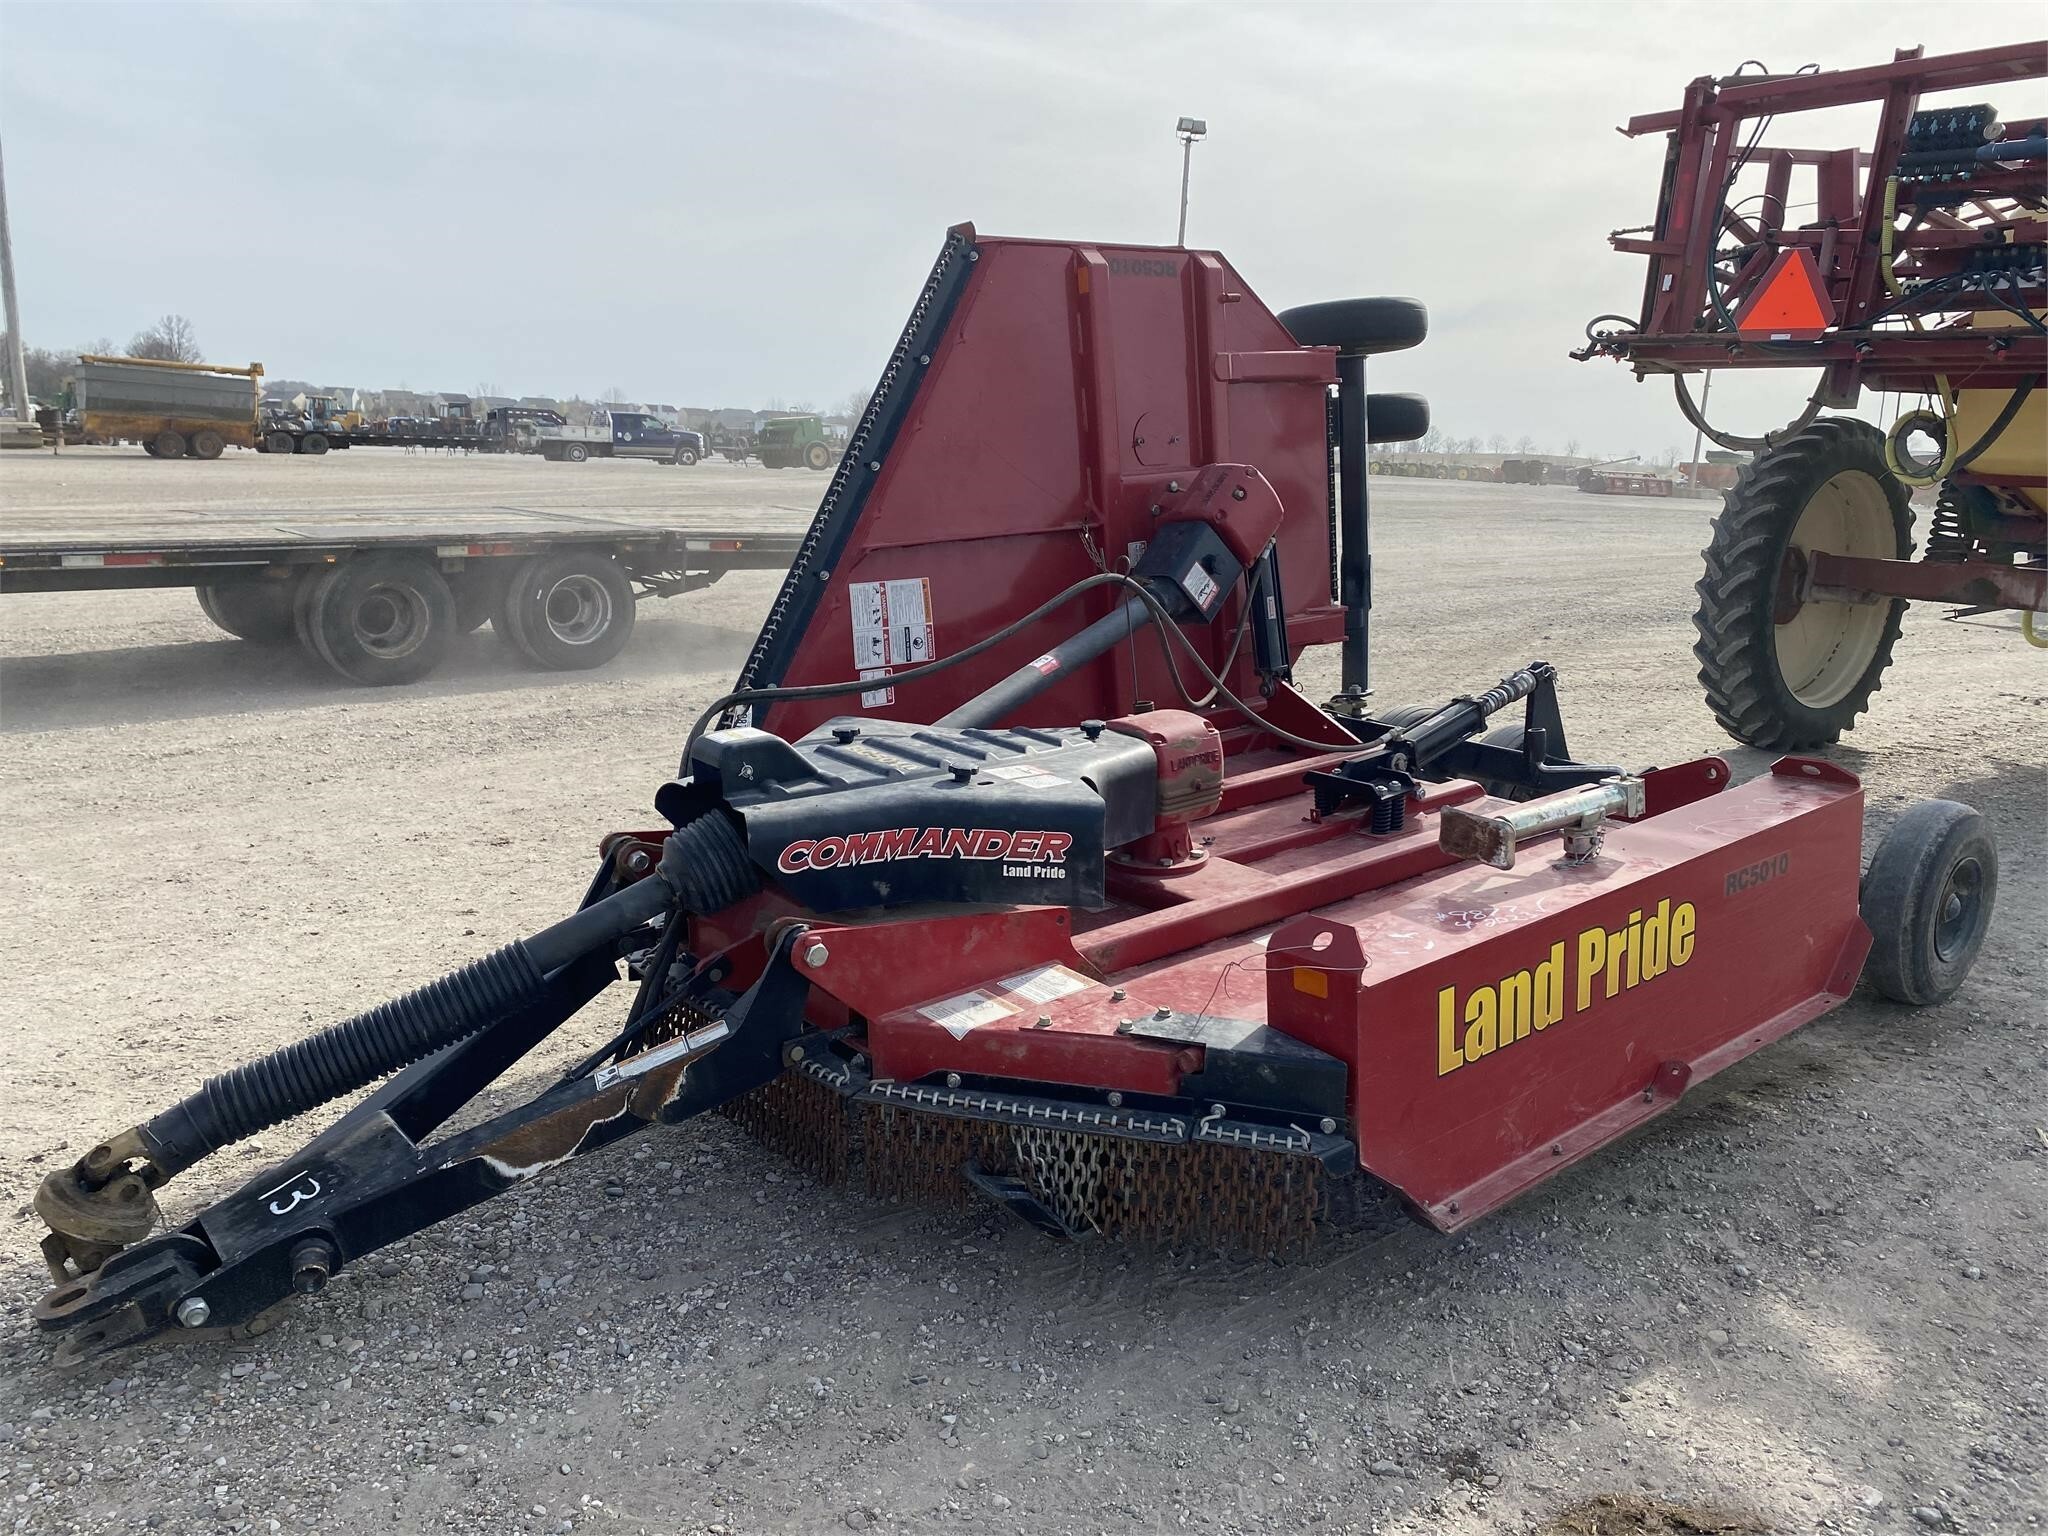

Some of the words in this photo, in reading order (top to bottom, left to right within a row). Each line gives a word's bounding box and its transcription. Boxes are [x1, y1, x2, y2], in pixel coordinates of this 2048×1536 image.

[778, 827, 1073, 874] COMMANDER
[1003, 864, 1031, 878] Land
[1033, 865, 1066, 880] Pride
[1725, 853, 1789, 896] RC5010
[1437, 940, 1565, 1078] Land
[1575, 897, 1697, 1013] Pride
